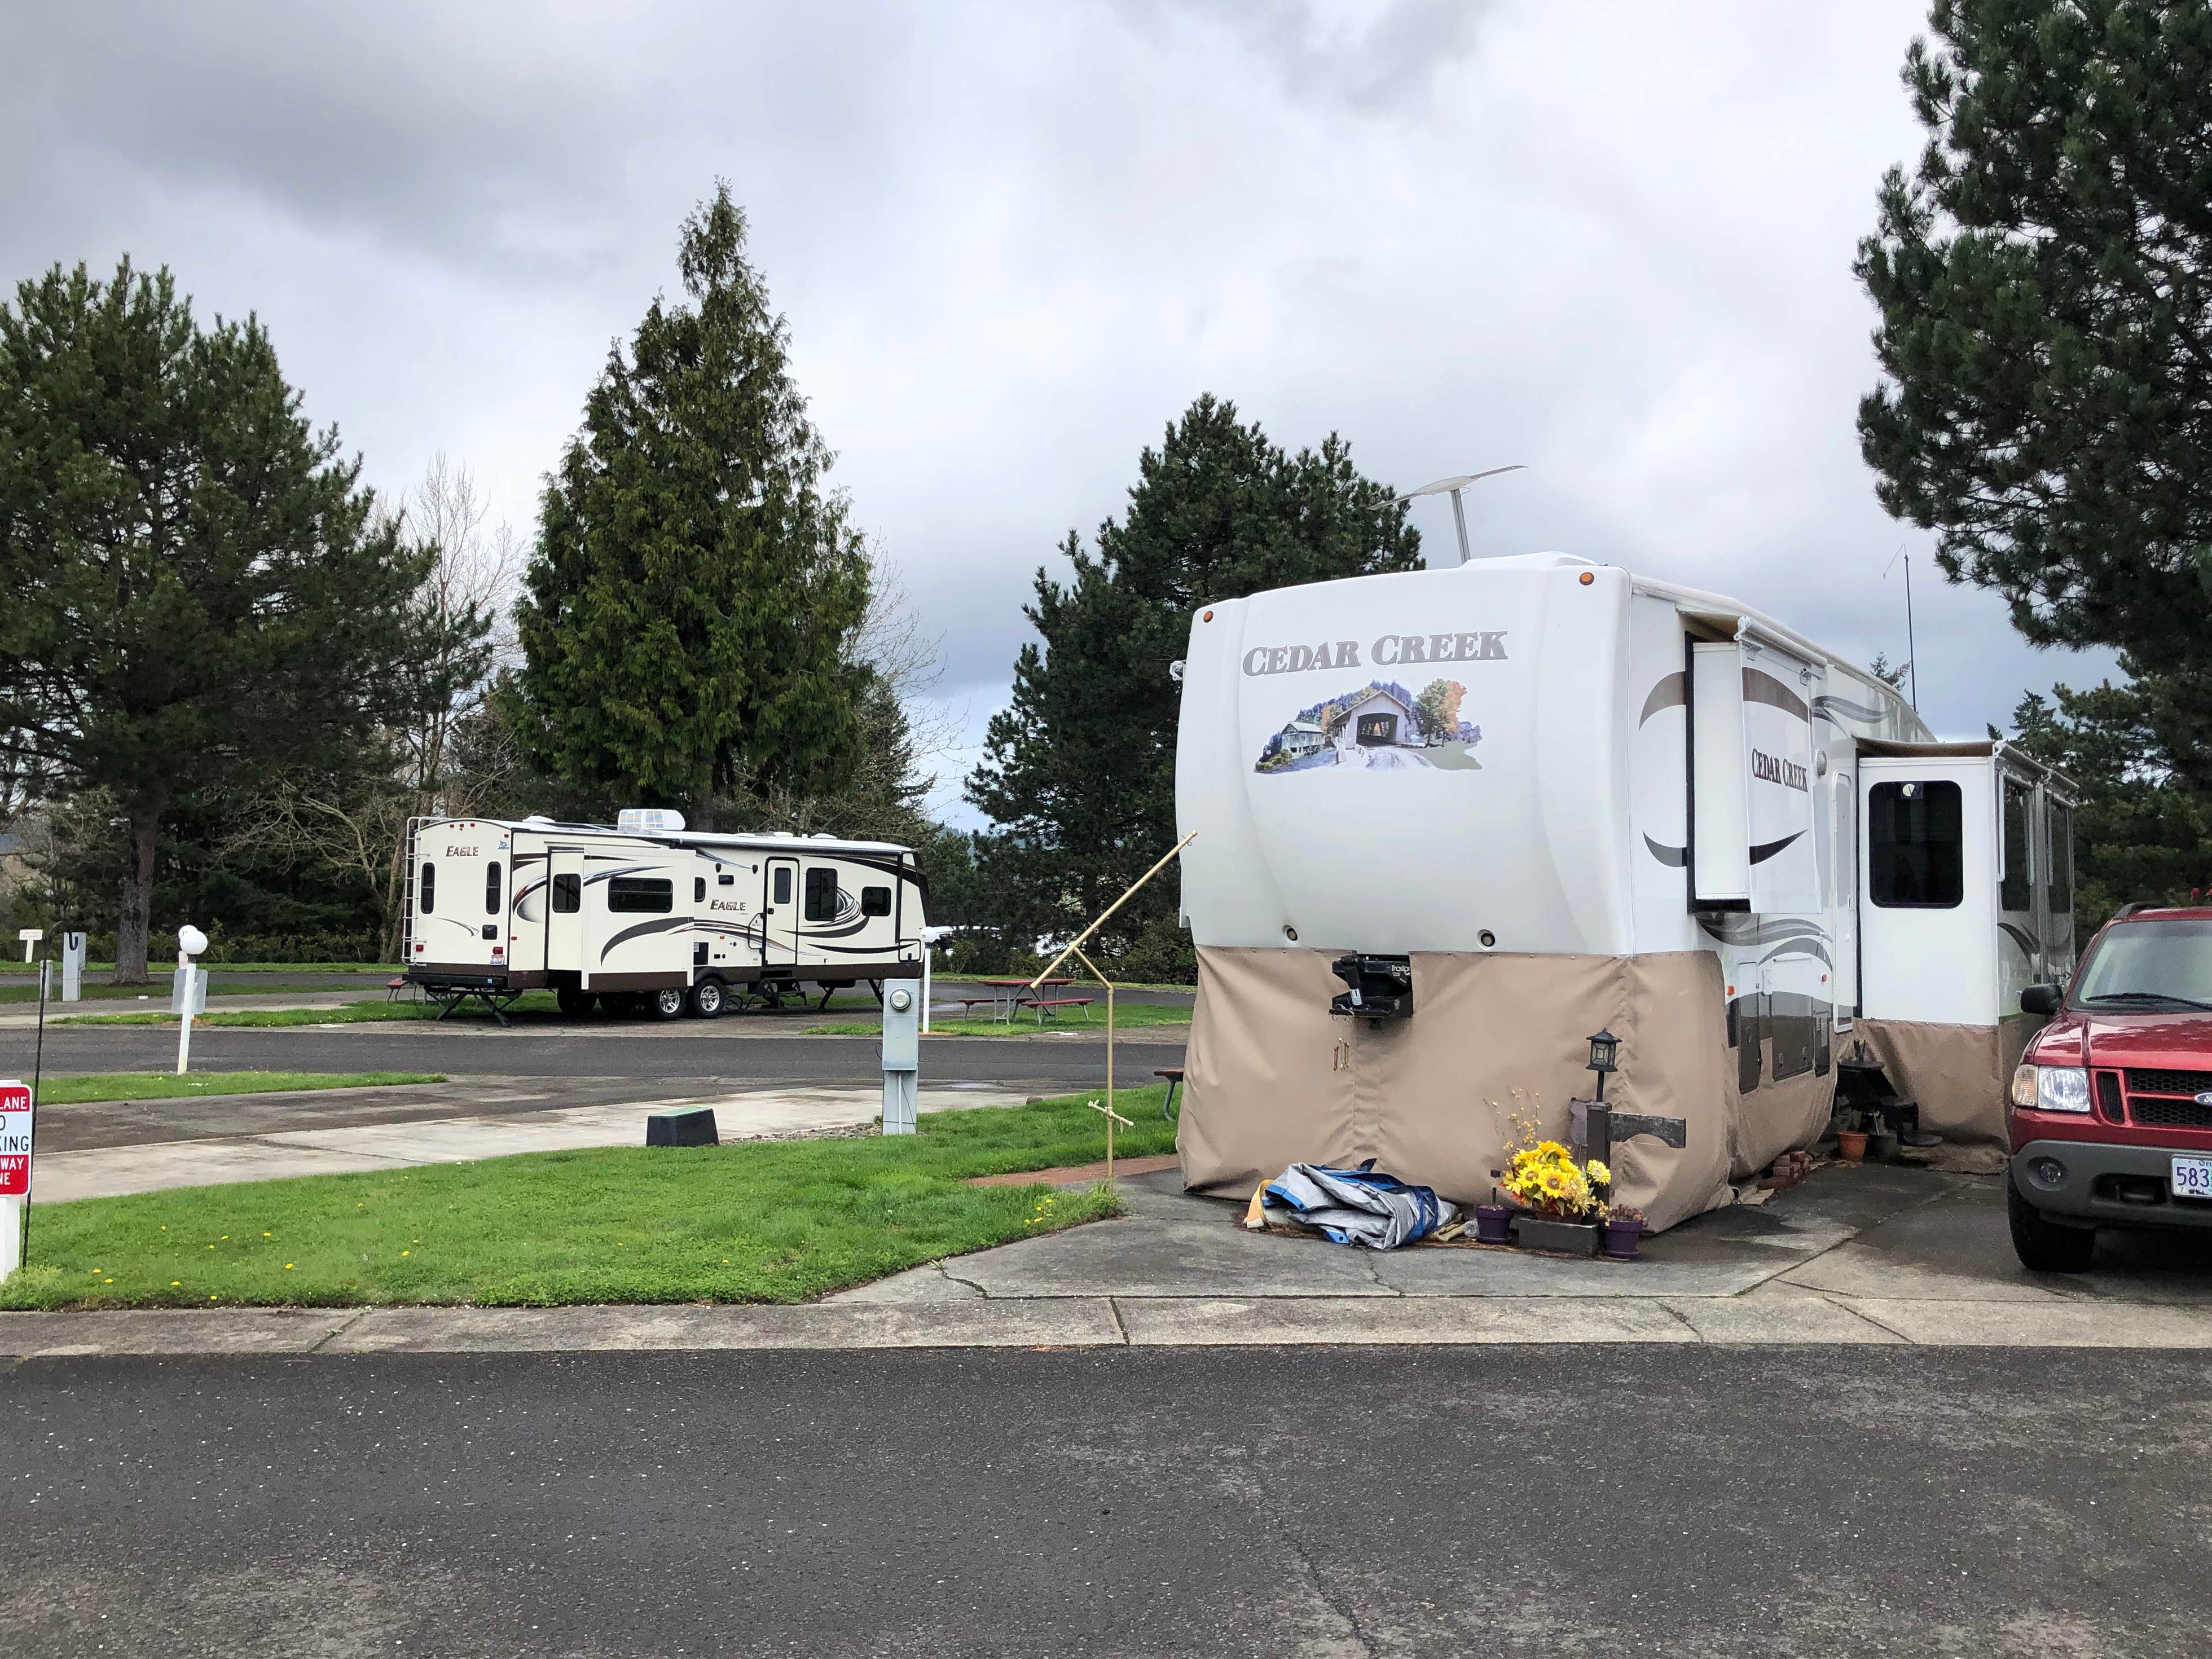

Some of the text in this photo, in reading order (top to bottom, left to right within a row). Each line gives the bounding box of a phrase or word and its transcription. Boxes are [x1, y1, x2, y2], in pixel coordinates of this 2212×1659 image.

[1242, 631, 1508, 676] CEDAR CREEK
[1752, 748, 1808, 793] CEDAR CREEK
[446, 845, 479, 857] EAGLE
[710, 899, 746, 911] EAGLE
[0, 1136, 29, 1152] ING
[2176, 1166, 2210, 1187] 583
